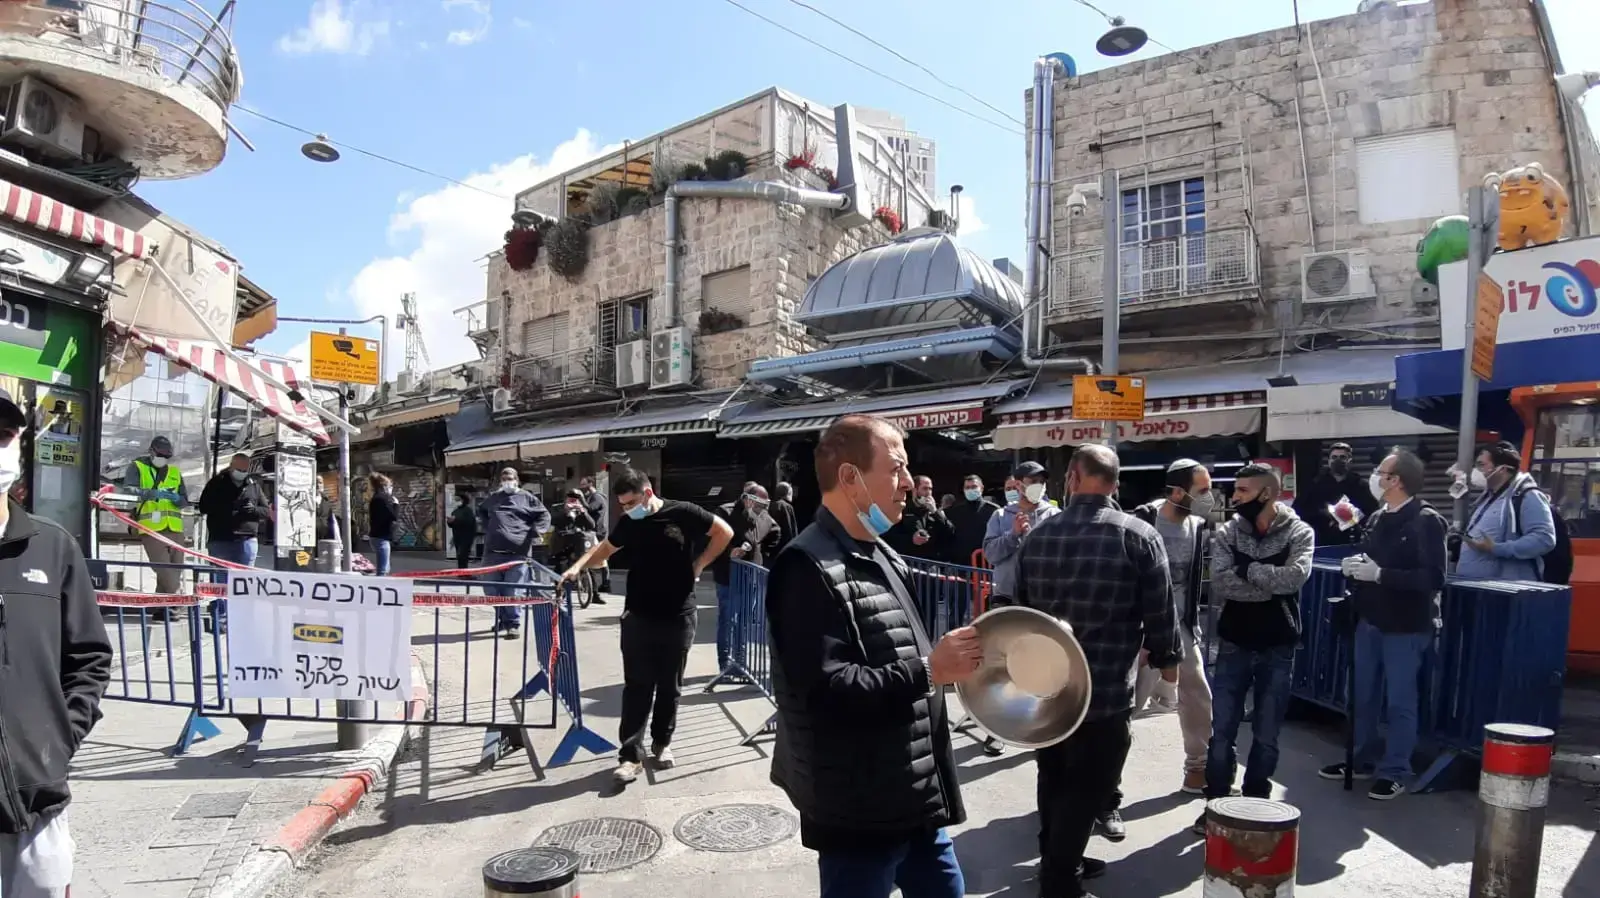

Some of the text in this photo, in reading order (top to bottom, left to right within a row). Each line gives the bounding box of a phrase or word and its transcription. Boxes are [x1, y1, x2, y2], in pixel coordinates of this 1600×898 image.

[1553, 325, 1576, 335] הפיס
[920, 411, 969, 427] פלאפל
[1132, 419, 1190, 436] פלאפל
[1047, 426, 1065, 441] לוי
[233, 576, 304, 598] הבאים
[312, 582, 404, 606] ברוכים
[296, 653, 342, 671] סניף
[234, 667, 401, 696] שוק מחנה יהודה
